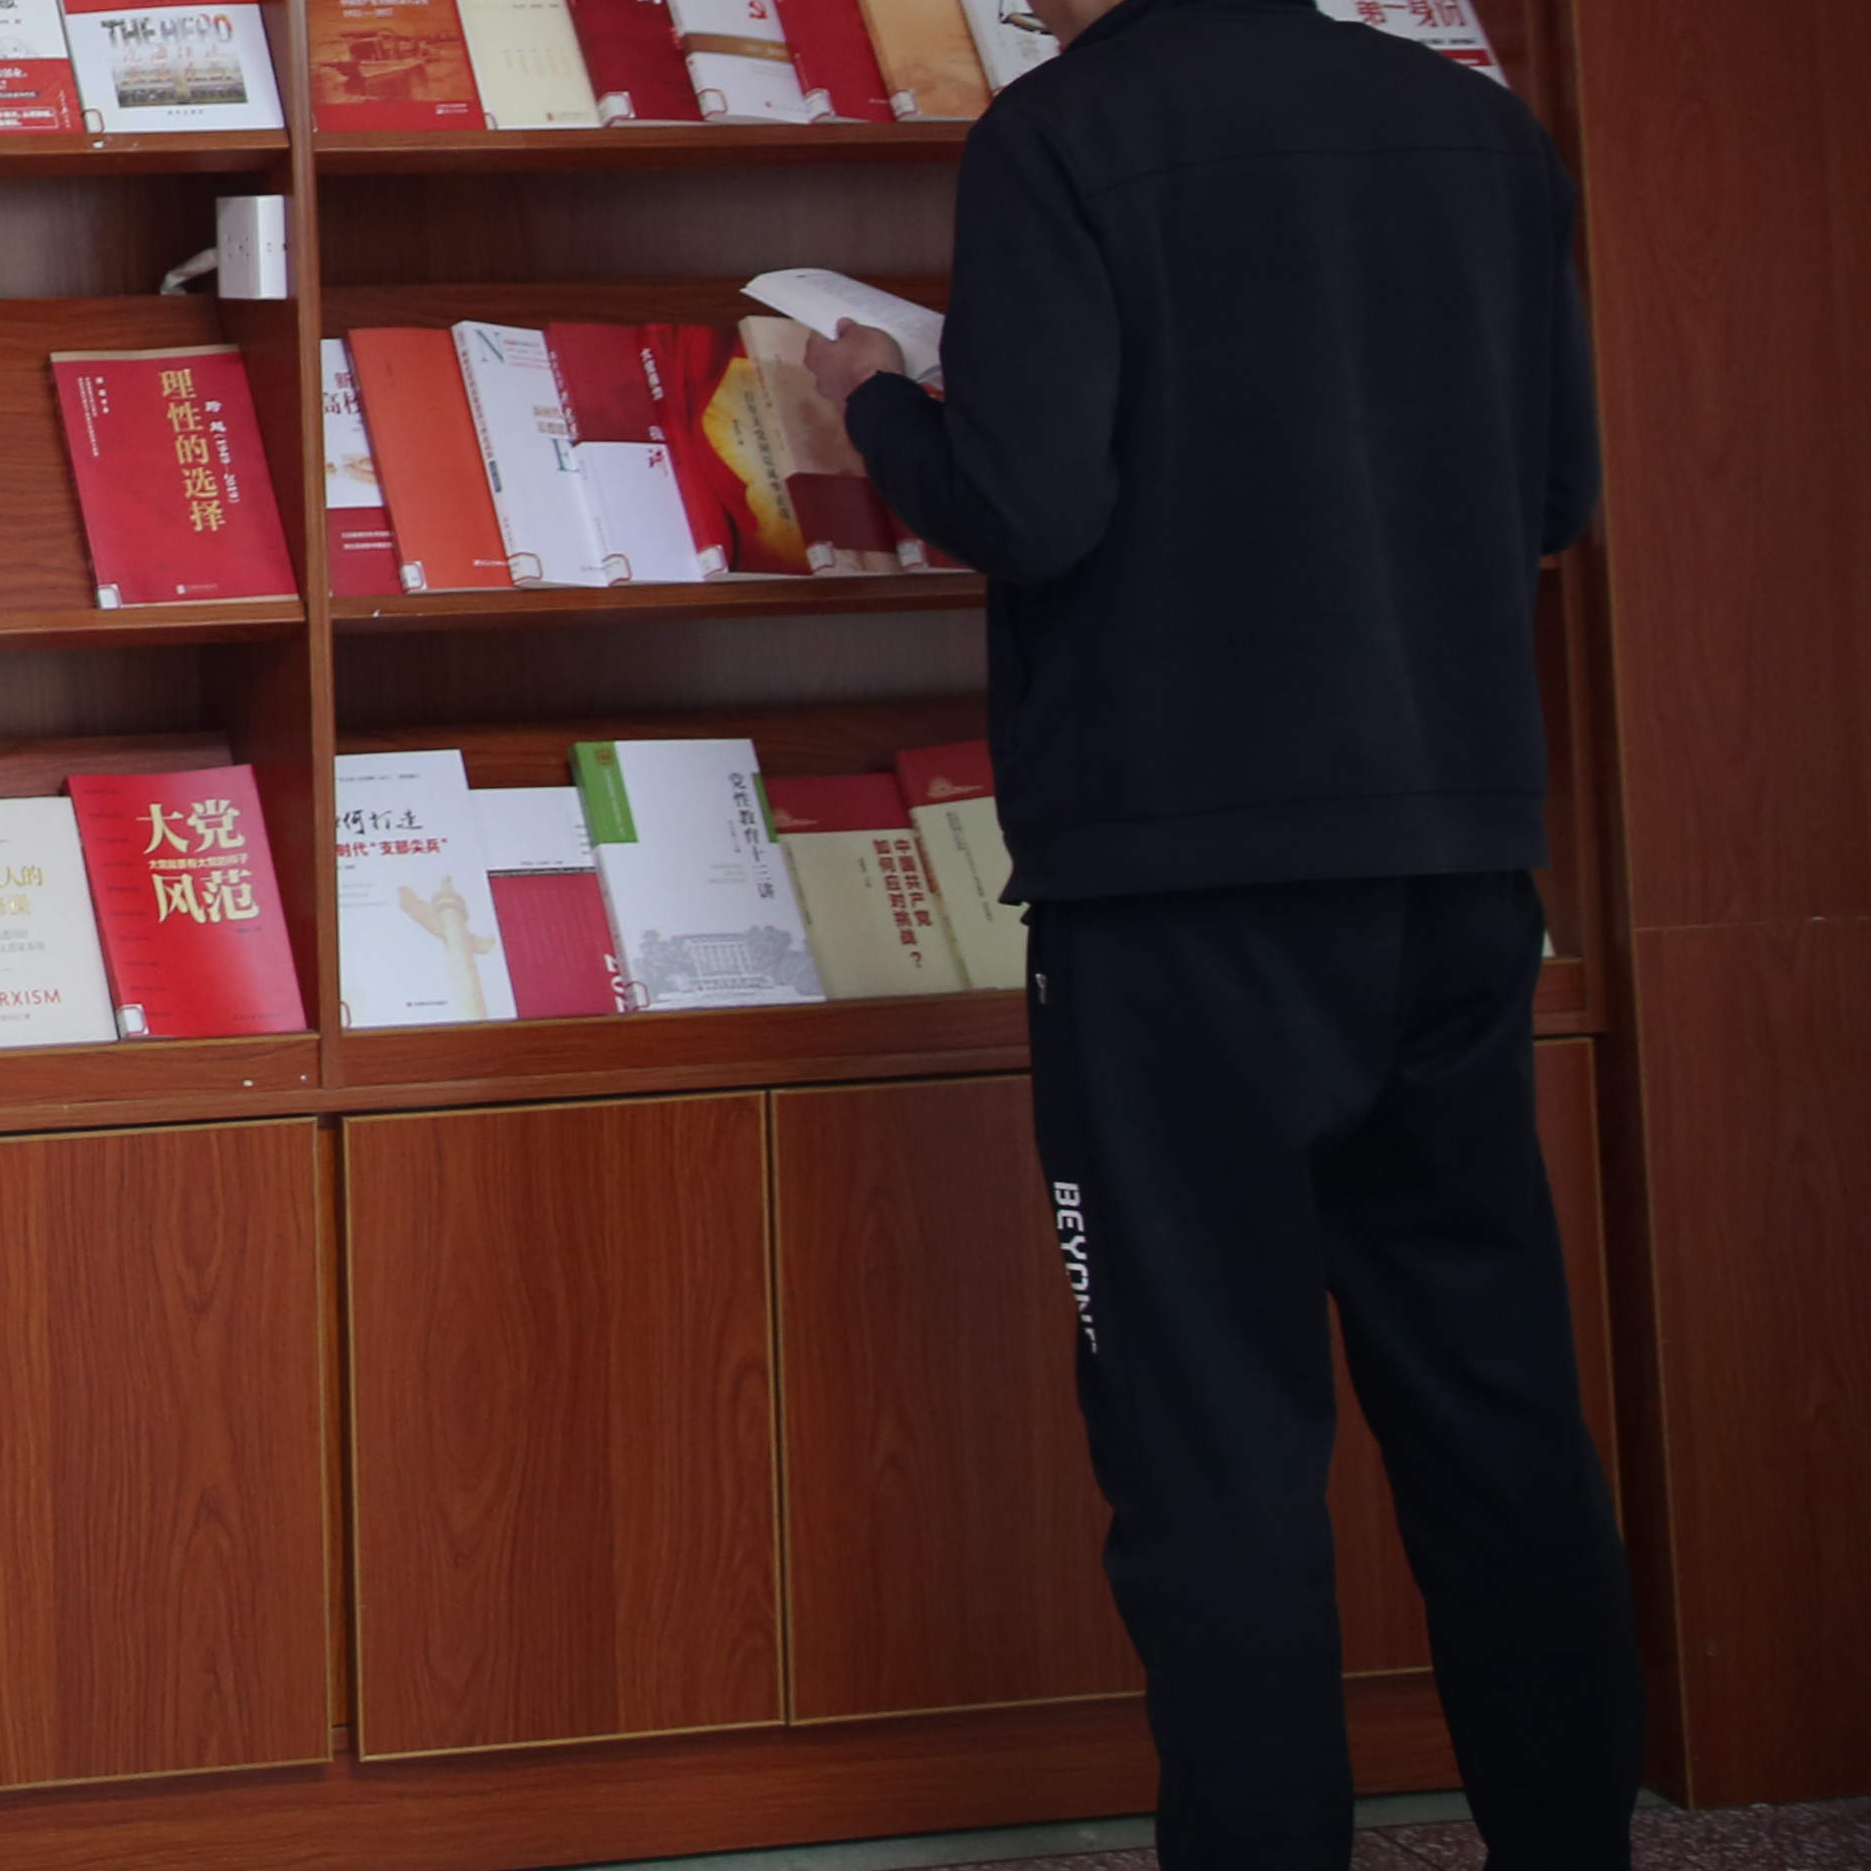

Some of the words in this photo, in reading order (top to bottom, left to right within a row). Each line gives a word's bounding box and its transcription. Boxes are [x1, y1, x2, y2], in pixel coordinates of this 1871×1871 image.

[159, 368, 226, 533] 理性的选择
[136, 798, 247, 855] 大党
[336, 807, 425, 835] 何打造
[151, 869, 260, 925] 风范
